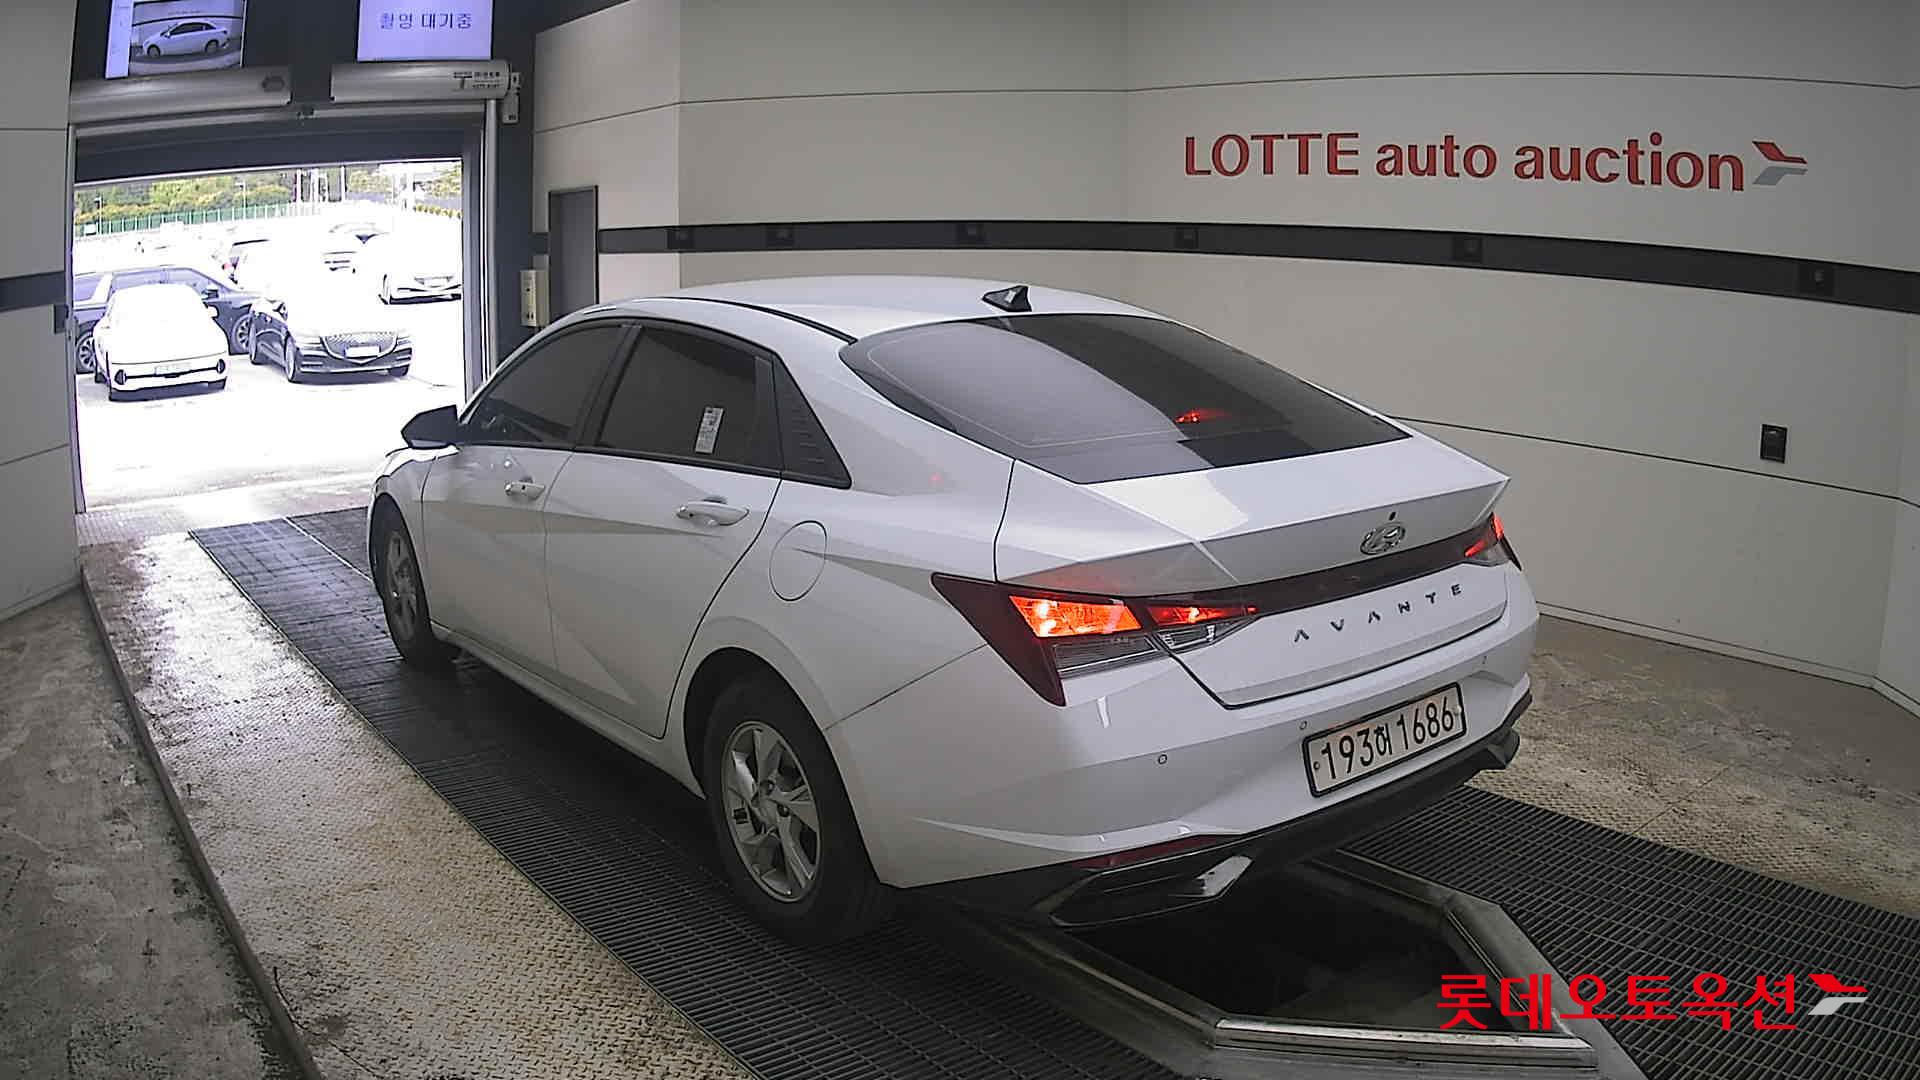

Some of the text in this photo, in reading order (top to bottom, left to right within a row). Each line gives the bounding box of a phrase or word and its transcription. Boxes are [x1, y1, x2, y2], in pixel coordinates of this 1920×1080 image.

[421, 12, 472, 30] 대기중
[1185, 132, 1745, 191] LOTTE auto auction
[1293, 583, 1462, 643] AVANTE
